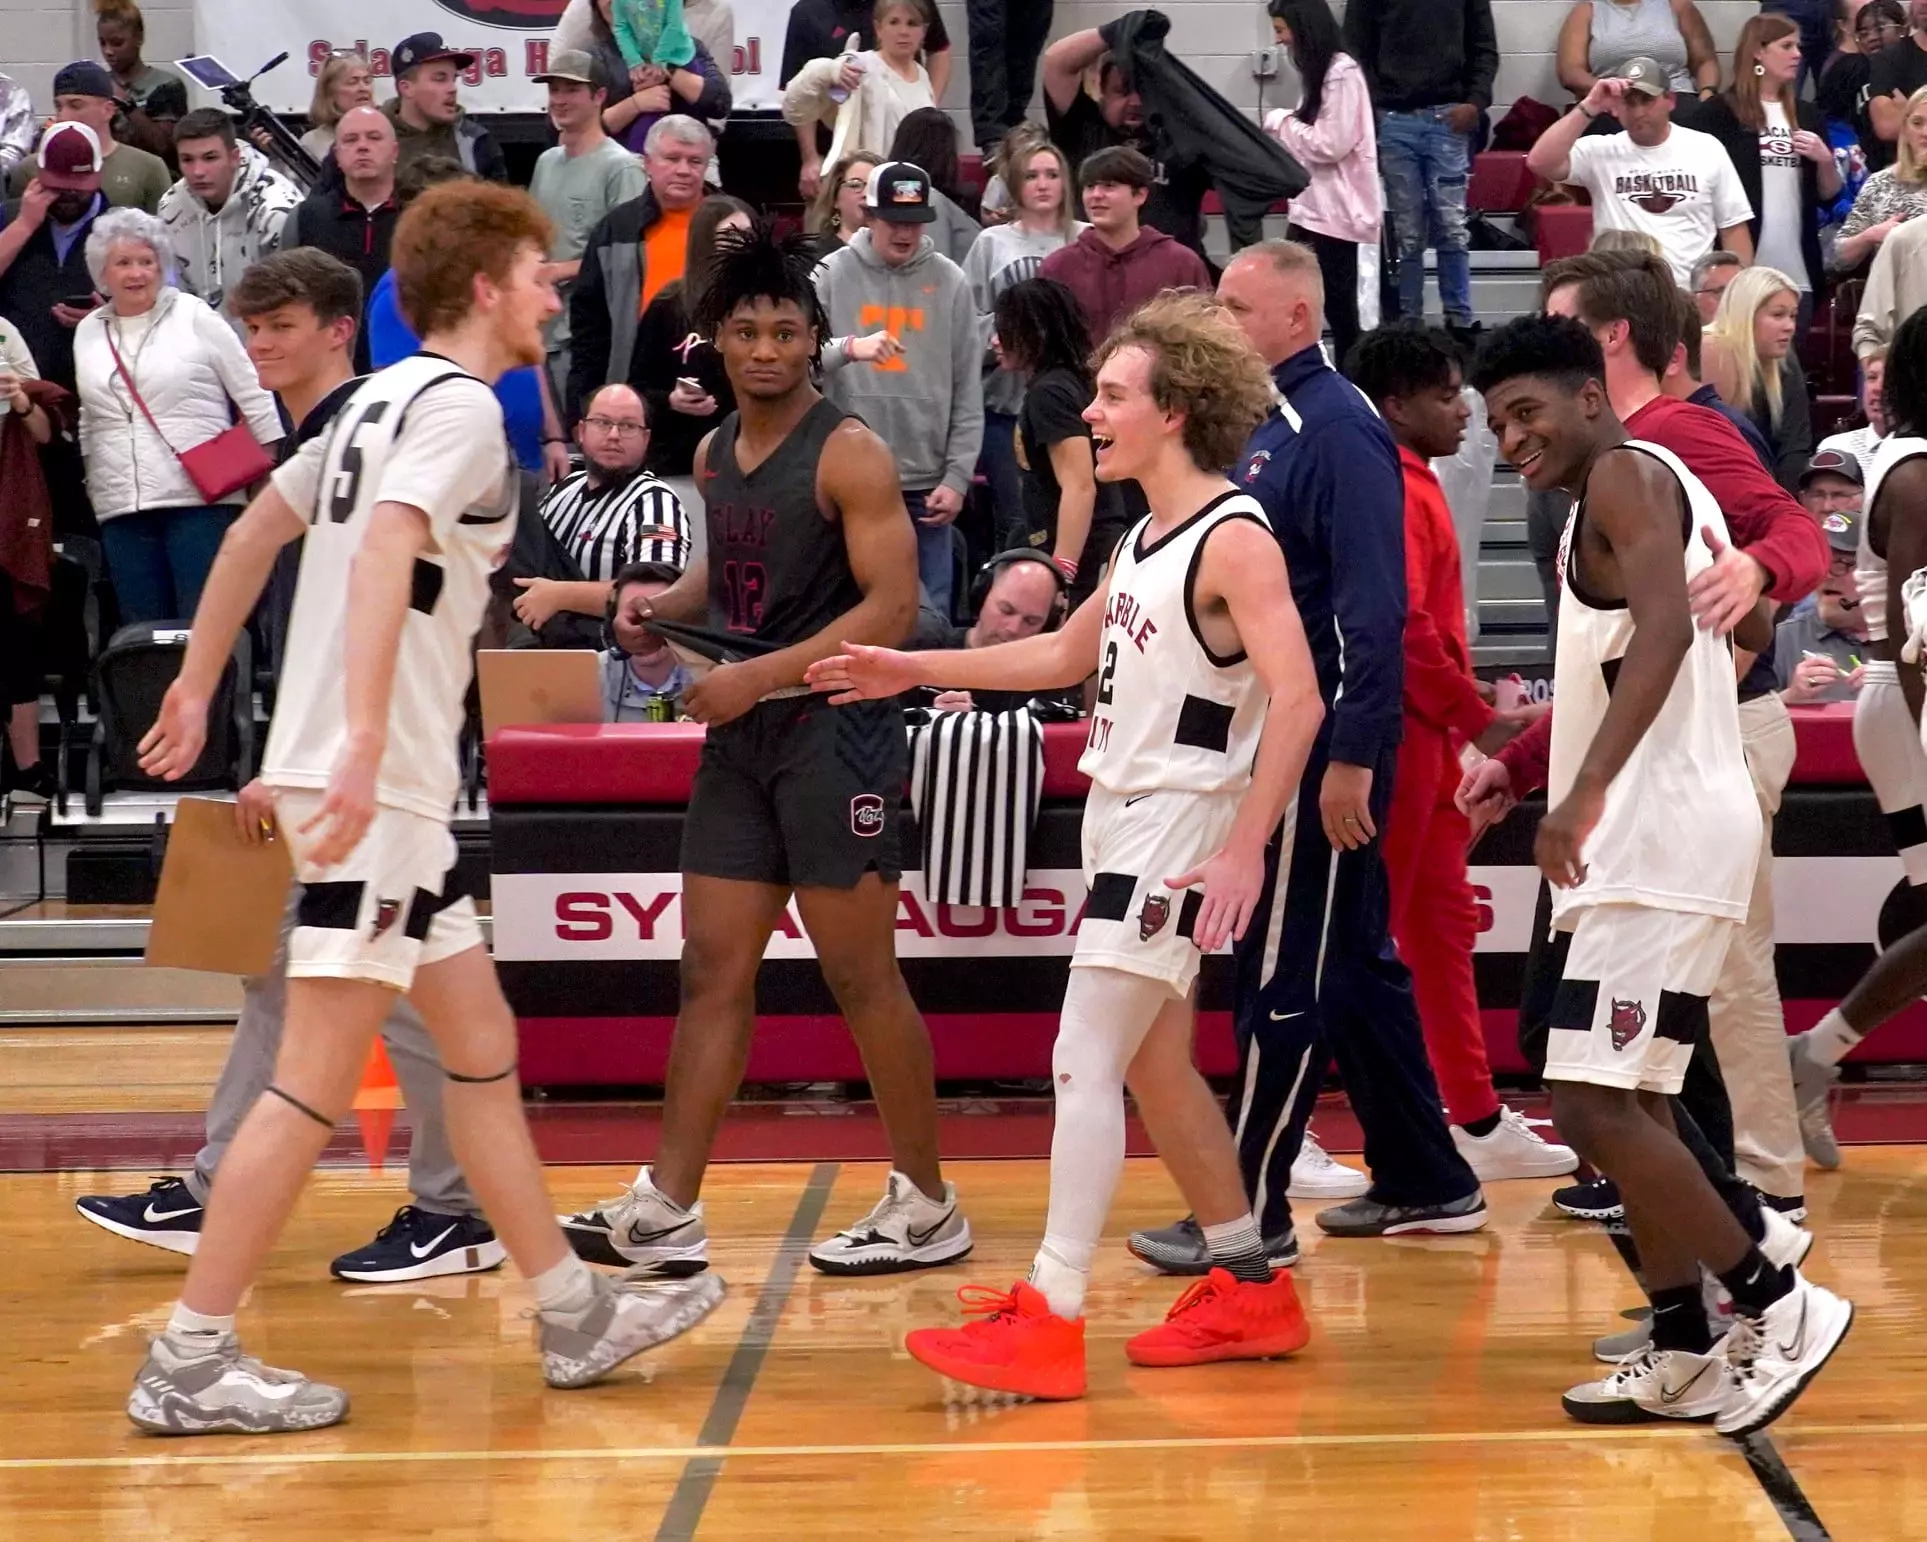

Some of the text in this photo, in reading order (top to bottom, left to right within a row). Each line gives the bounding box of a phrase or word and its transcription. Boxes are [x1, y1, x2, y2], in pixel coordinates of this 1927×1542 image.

[1615, 174, 1698, 194] BASKETBALL
[724, 560, 767, 633] 12
[1104, 592, 1158, 655] ARBLE
[1088, 715, 1114, 753] ITY
